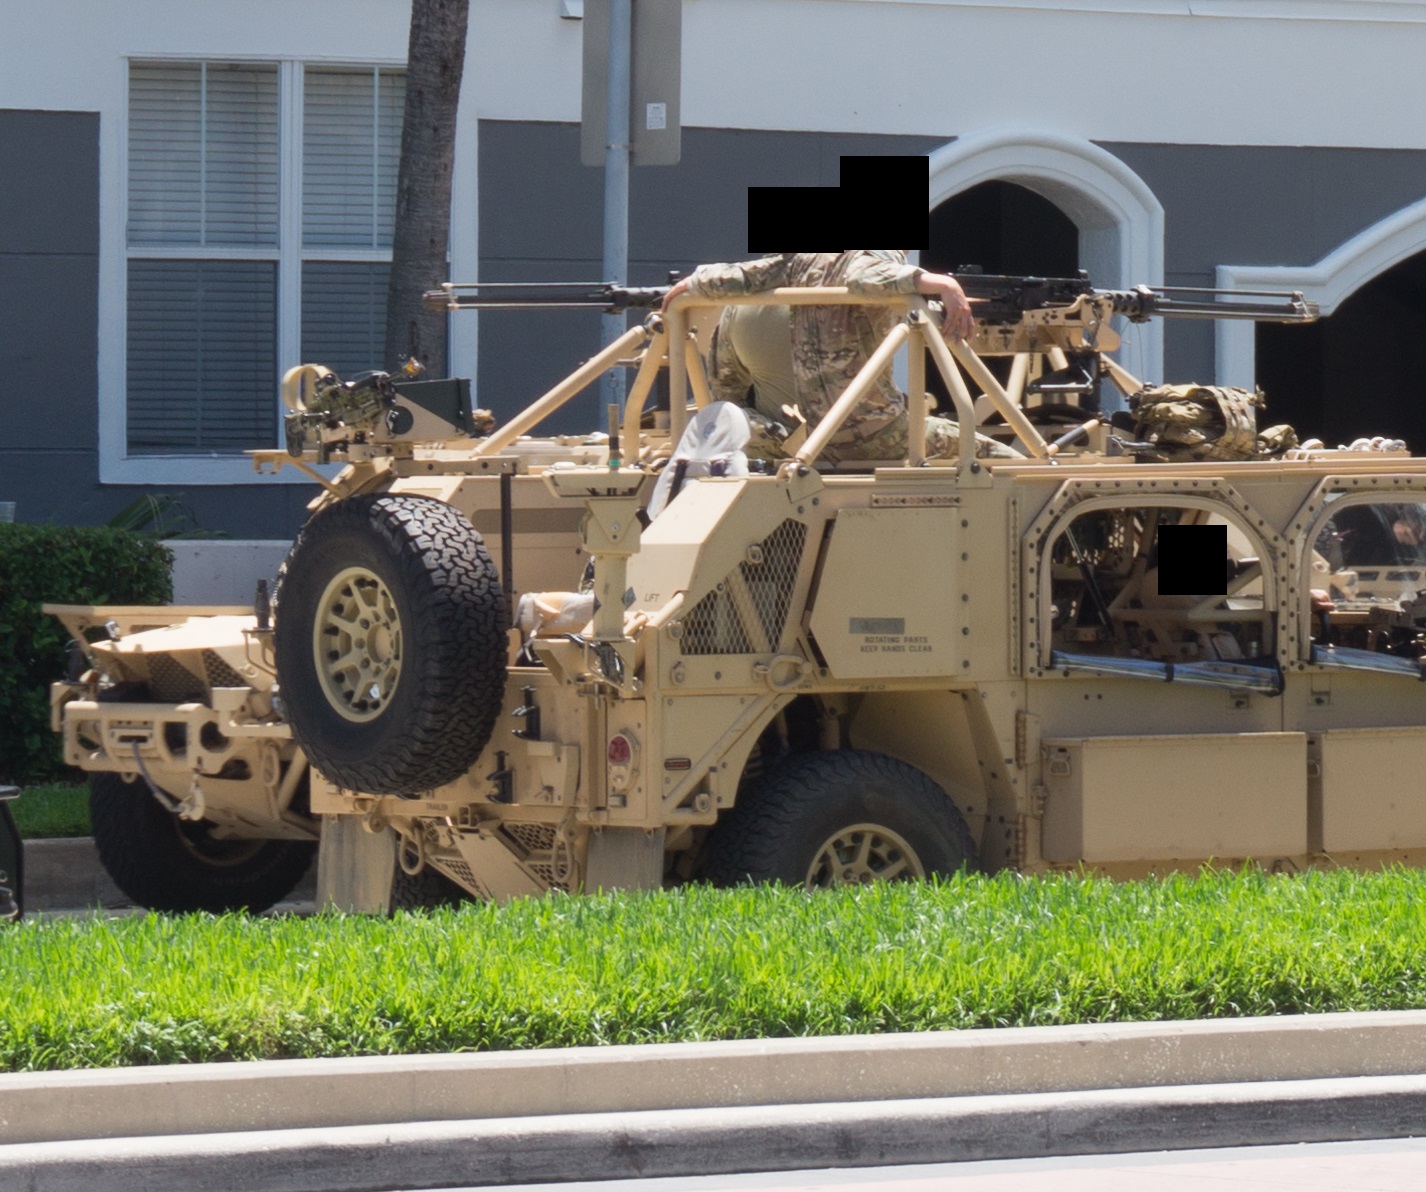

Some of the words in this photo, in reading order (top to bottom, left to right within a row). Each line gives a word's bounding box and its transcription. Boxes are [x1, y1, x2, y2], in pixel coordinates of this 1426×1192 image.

[864, 636, 900, 644] ROTATING
[903, 636, 929, 644] PARTS
[860, 645, 879, 653] KEEP
[881, 645, 906, 653] HANDS
[908, 645, 932, 653] CLEAR
